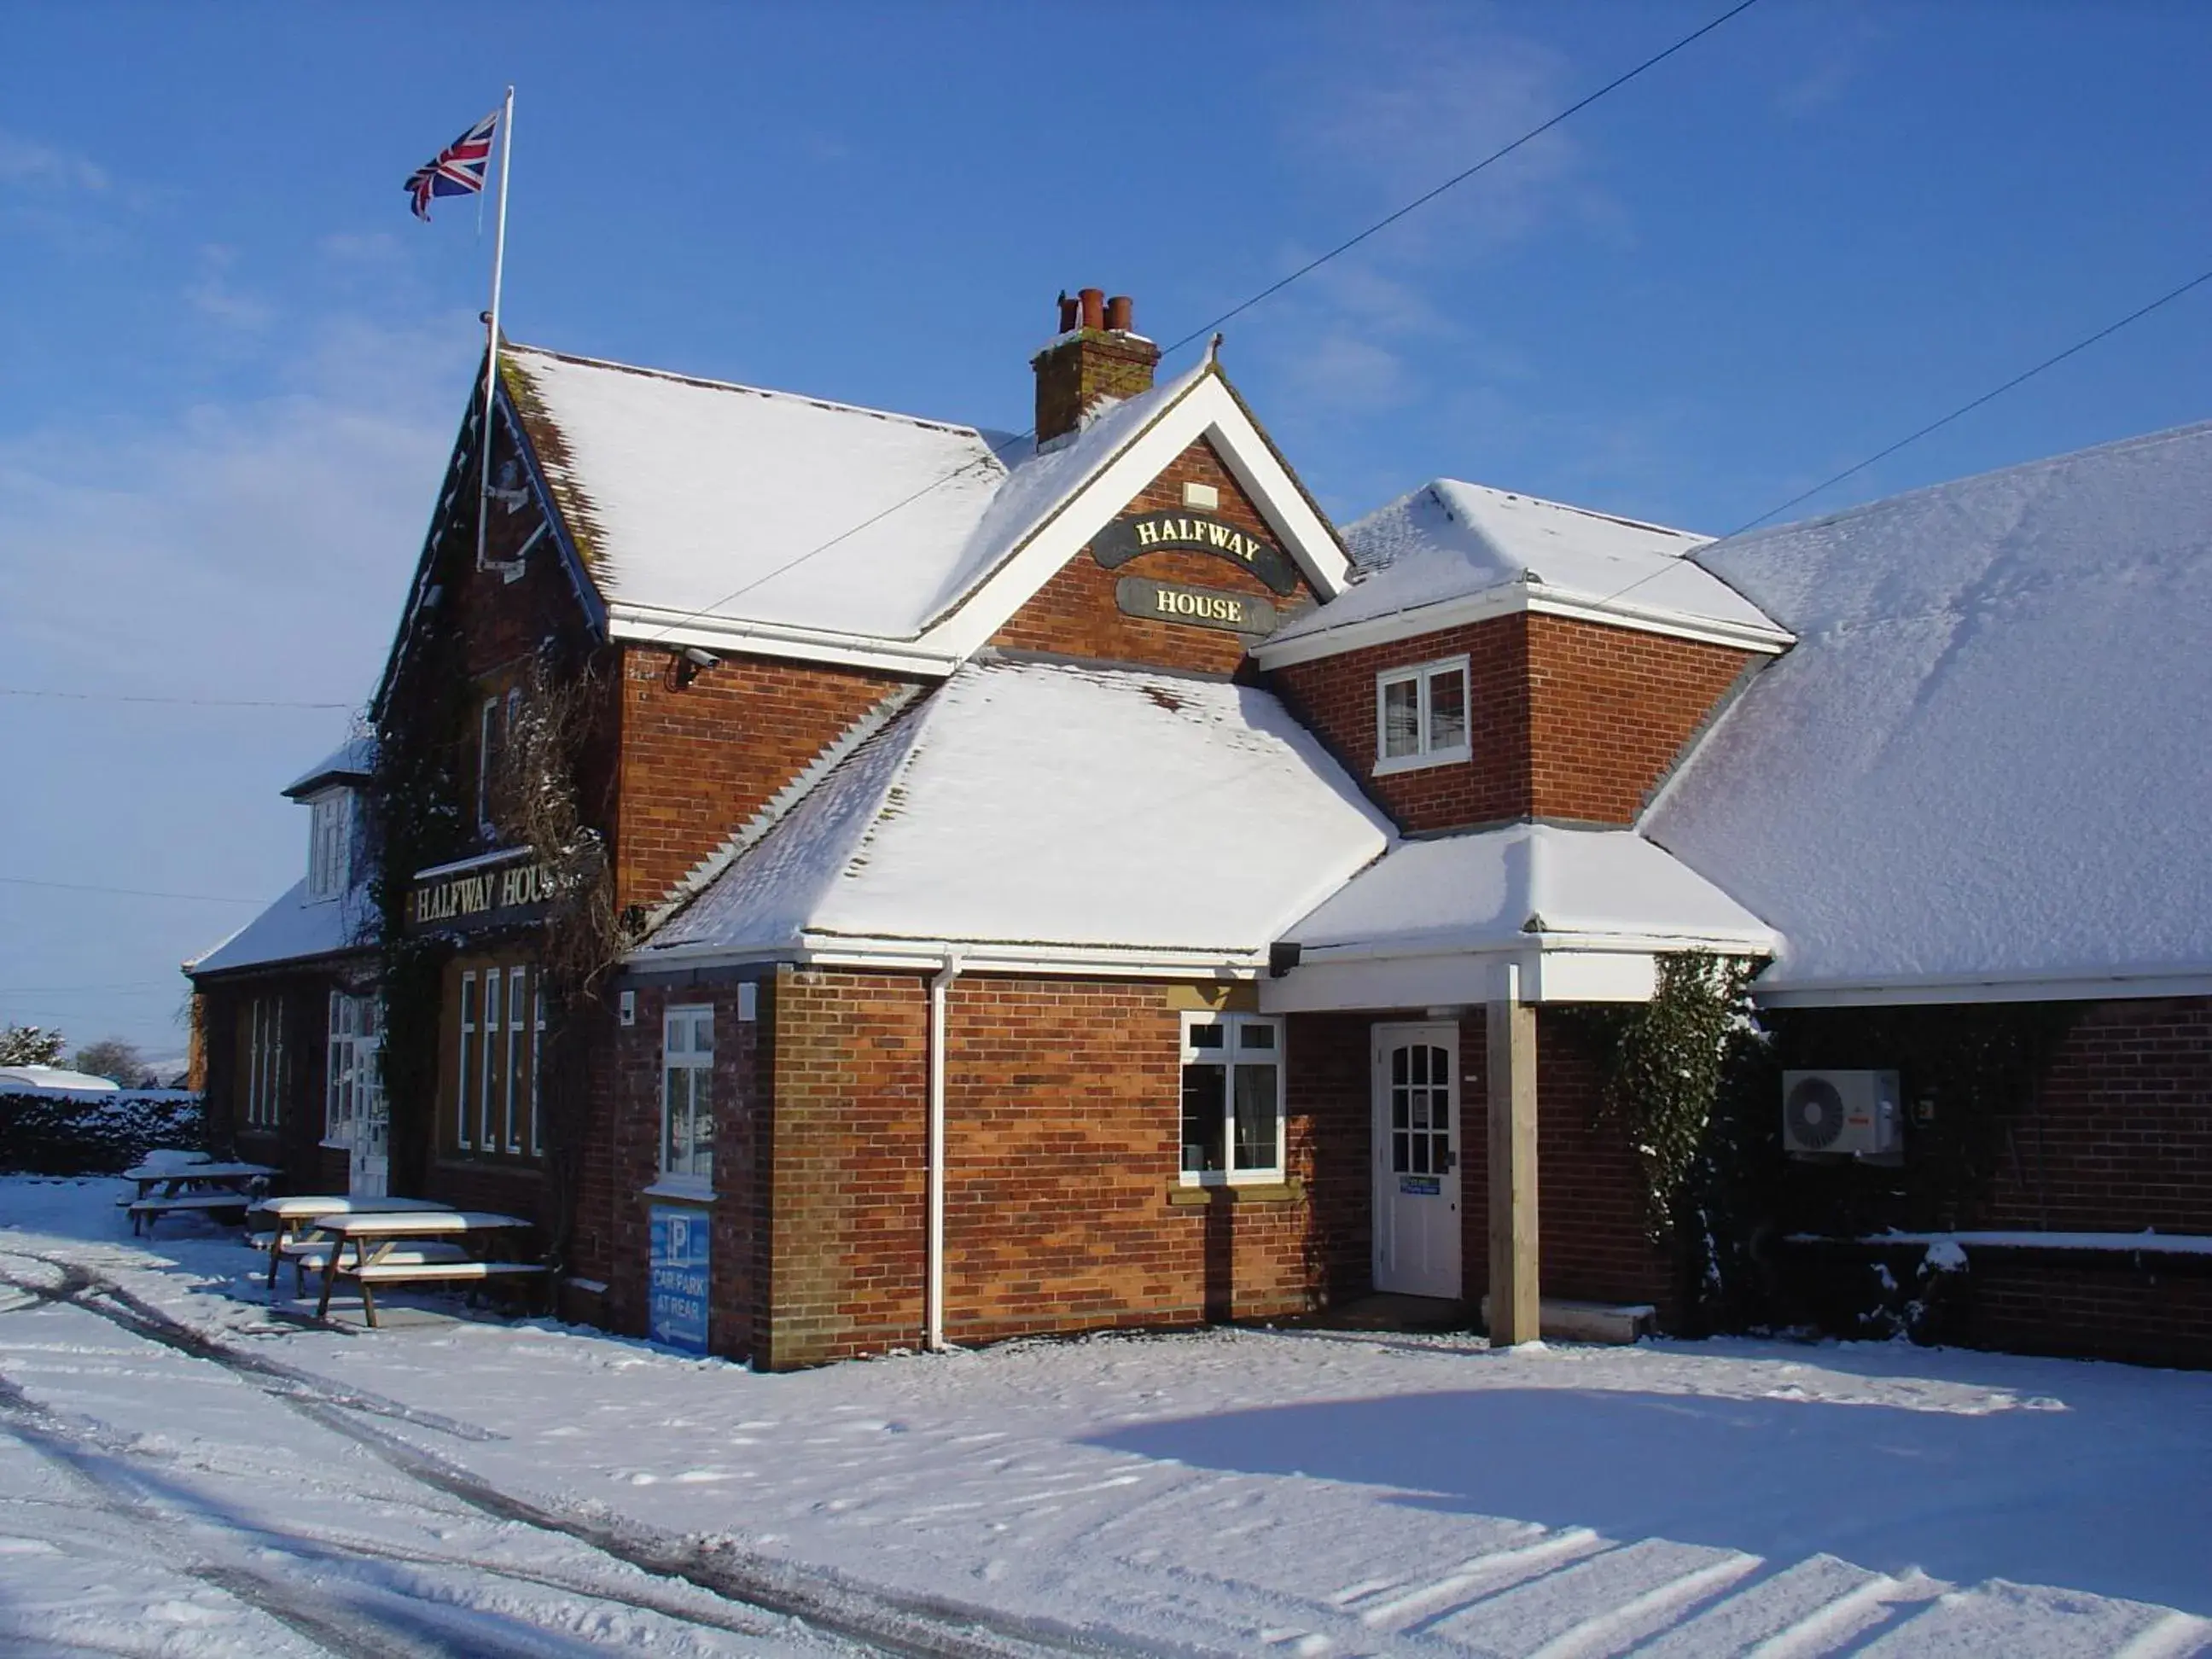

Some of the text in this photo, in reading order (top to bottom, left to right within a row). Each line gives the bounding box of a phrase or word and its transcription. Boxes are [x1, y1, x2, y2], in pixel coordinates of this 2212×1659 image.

[1136, 519, 1260, 561] HALFWAY
[1157, 591, 1243, 622] HOUSE
[417, 874, 495, 922] HALFWAY
[673, 1220, 686, 1260] P
[654, 1270, 705, 1295] CAR PARK
[656, 1294, 700, 1320] AT REAR
